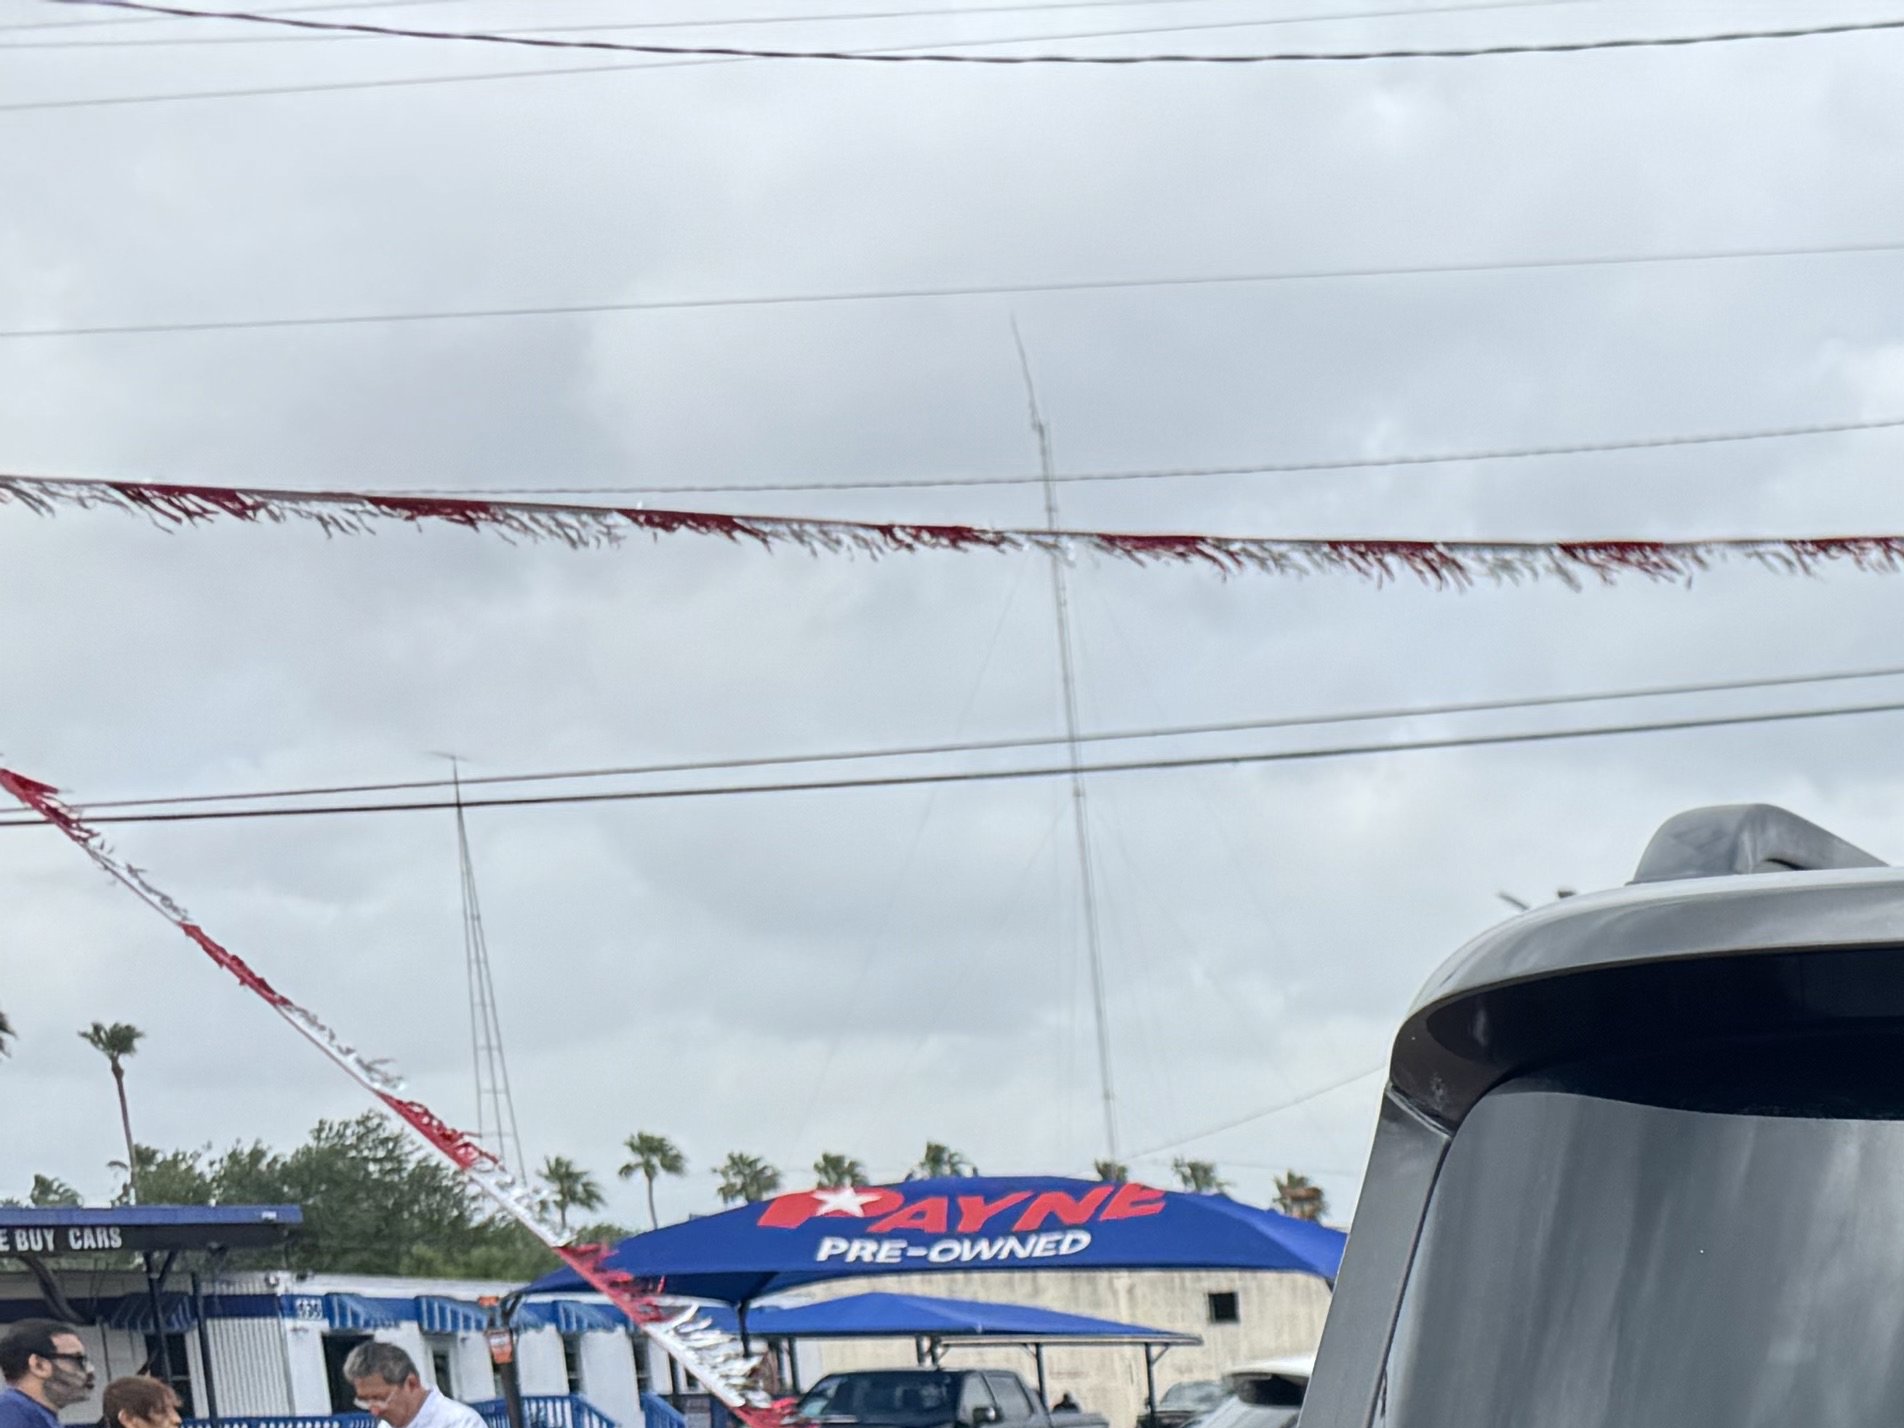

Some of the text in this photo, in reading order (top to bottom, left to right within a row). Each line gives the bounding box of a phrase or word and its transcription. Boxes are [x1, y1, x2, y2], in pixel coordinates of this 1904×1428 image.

[757, 1183, 1166, 1233] PAYNE
[15, 1228, 54, 1252] BUY
[68, 1226, 122, 1250] CARS
[816, 1230, 1092, 1264] PRE-OWNED
